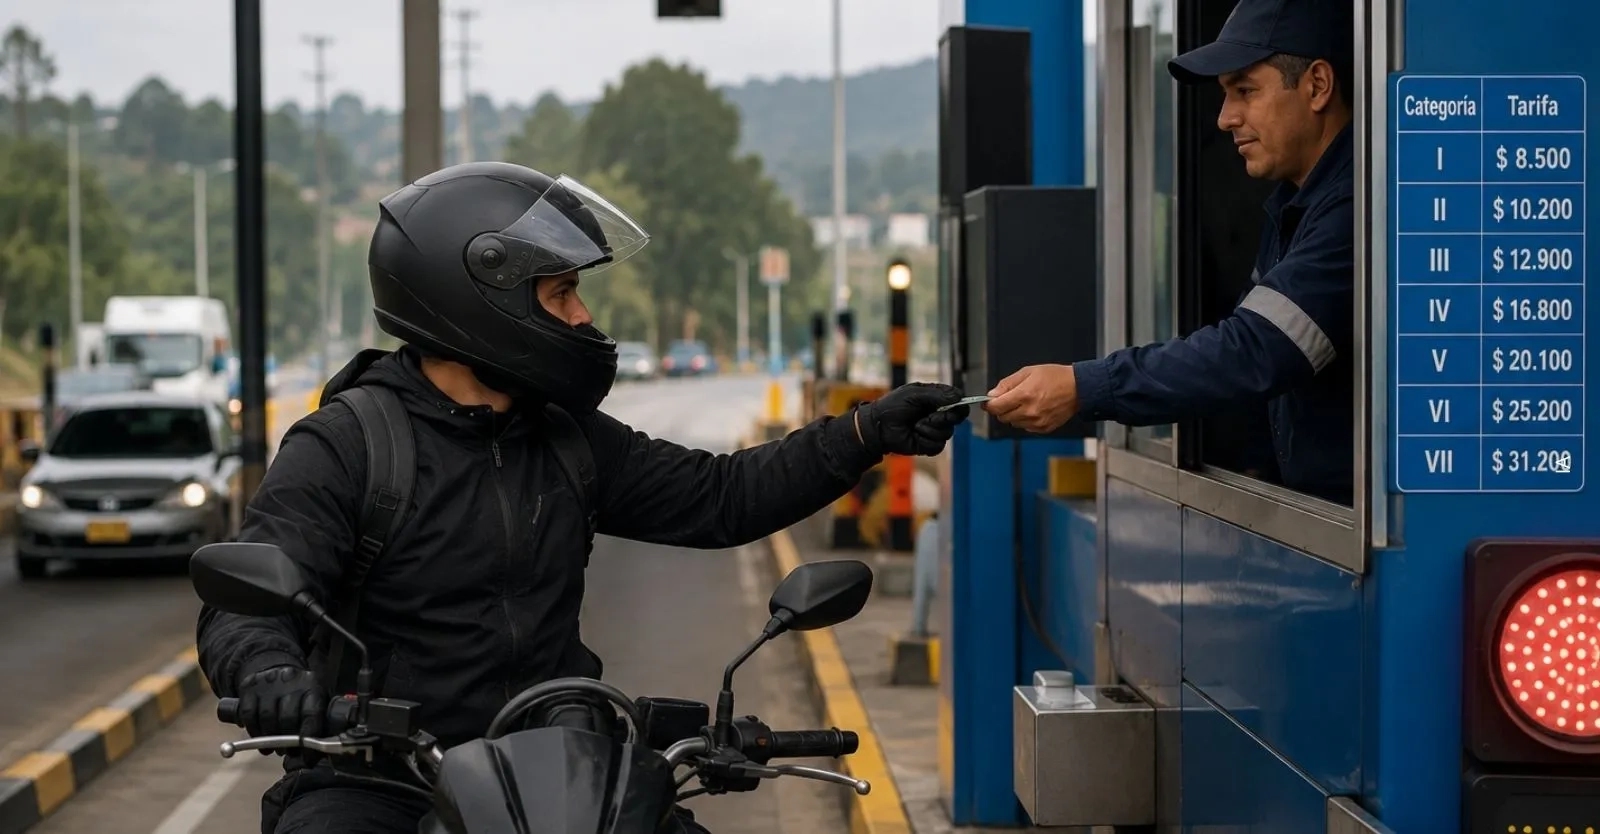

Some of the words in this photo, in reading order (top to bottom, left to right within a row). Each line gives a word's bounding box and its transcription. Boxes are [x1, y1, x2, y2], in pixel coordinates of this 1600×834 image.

[1404, 94, 1476, 121] Categoría
[1507, 94, 1558, 116] Tarifa
[1437, 146, 1443, 171] I
[1496, 144, 1508, 172] $
[1515, 147, 1571, 169] 8.500
[1434, 197, 1446, 221] II
[1493, 195, 1505, 223] $
[1510, 197, 1573, 220] 10.200
[1430, 247, 1449, 272] III
[1492, 245, 1505, 273] $
[1510, 248, 1573, 270] 12.900
[1429, 298, 1451, 322] IV
[1492, 296, 1504, 323] $
[1510, 298, 1573, 321] 16.800
[1431, 348, 1448, 372] V
[1492, 347, 1504, 374] $
[1509, 349, 1572, 371] 20.100
[1428, 399, 1450, 423] VI
[1492, 397, 1504, 424] $
[1508, 399, 1572, 422] 25.200
[1424, 449, 1453, 473] VII
[1492, 448, 1504, 475] $
